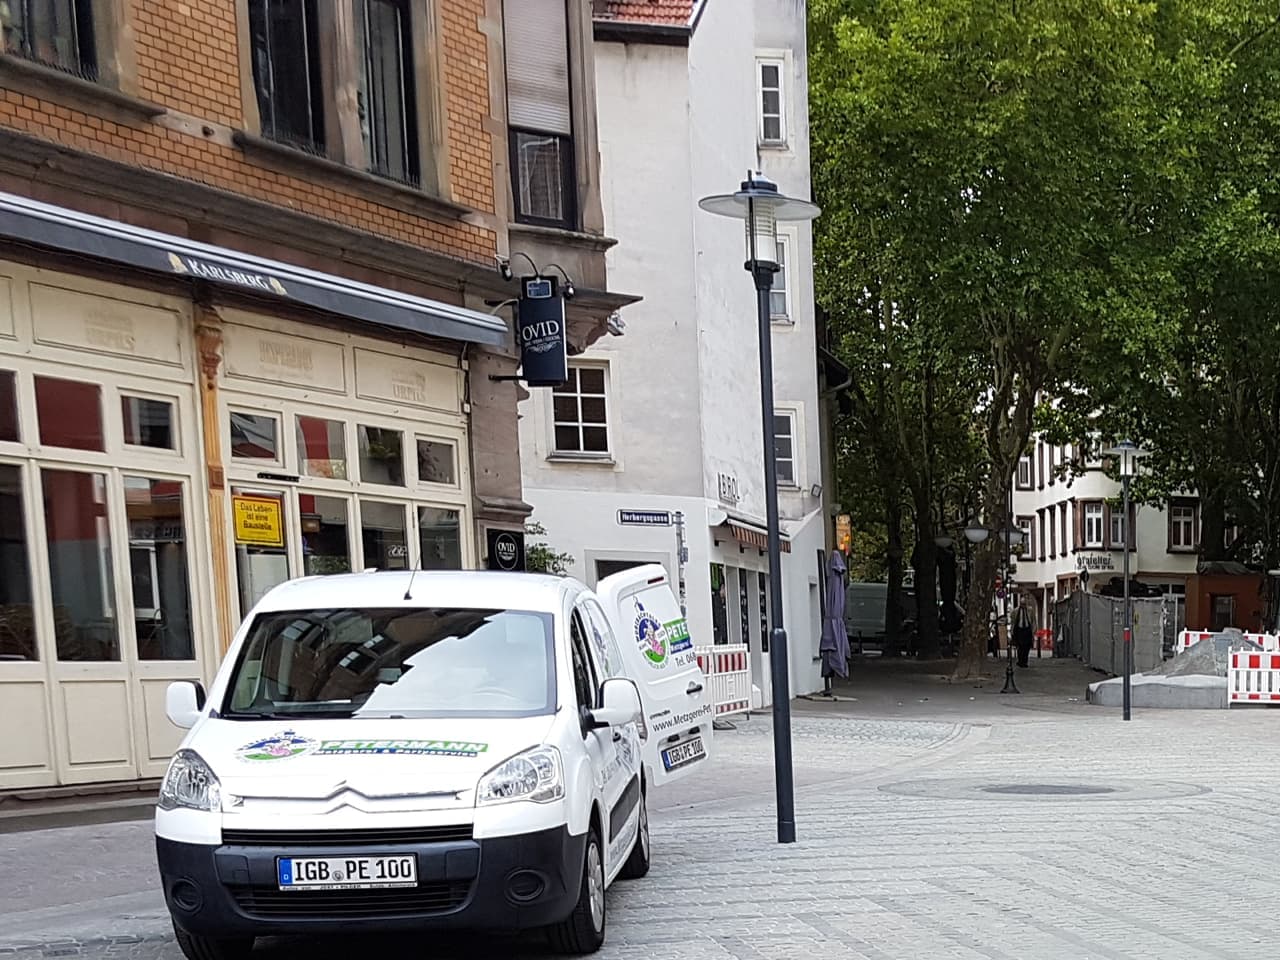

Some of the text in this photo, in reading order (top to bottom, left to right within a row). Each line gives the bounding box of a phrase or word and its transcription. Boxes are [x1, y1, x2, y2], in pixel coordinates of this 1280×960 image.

[187, 257, 269, 291] KARLSBERG
[522, 320, 560, 341] OVID
[240, 502, 272, 512] Das Leben
[243, 520, 272, 531] Baustelle
[497, 542, 515, 553] OVID
[322, 741, 487, 752] PETERMANN
[668, 748, 681, 764] IGB
[683, 743, 693, 758] PE
[295, 859, 413, 882] IGB PE 100
